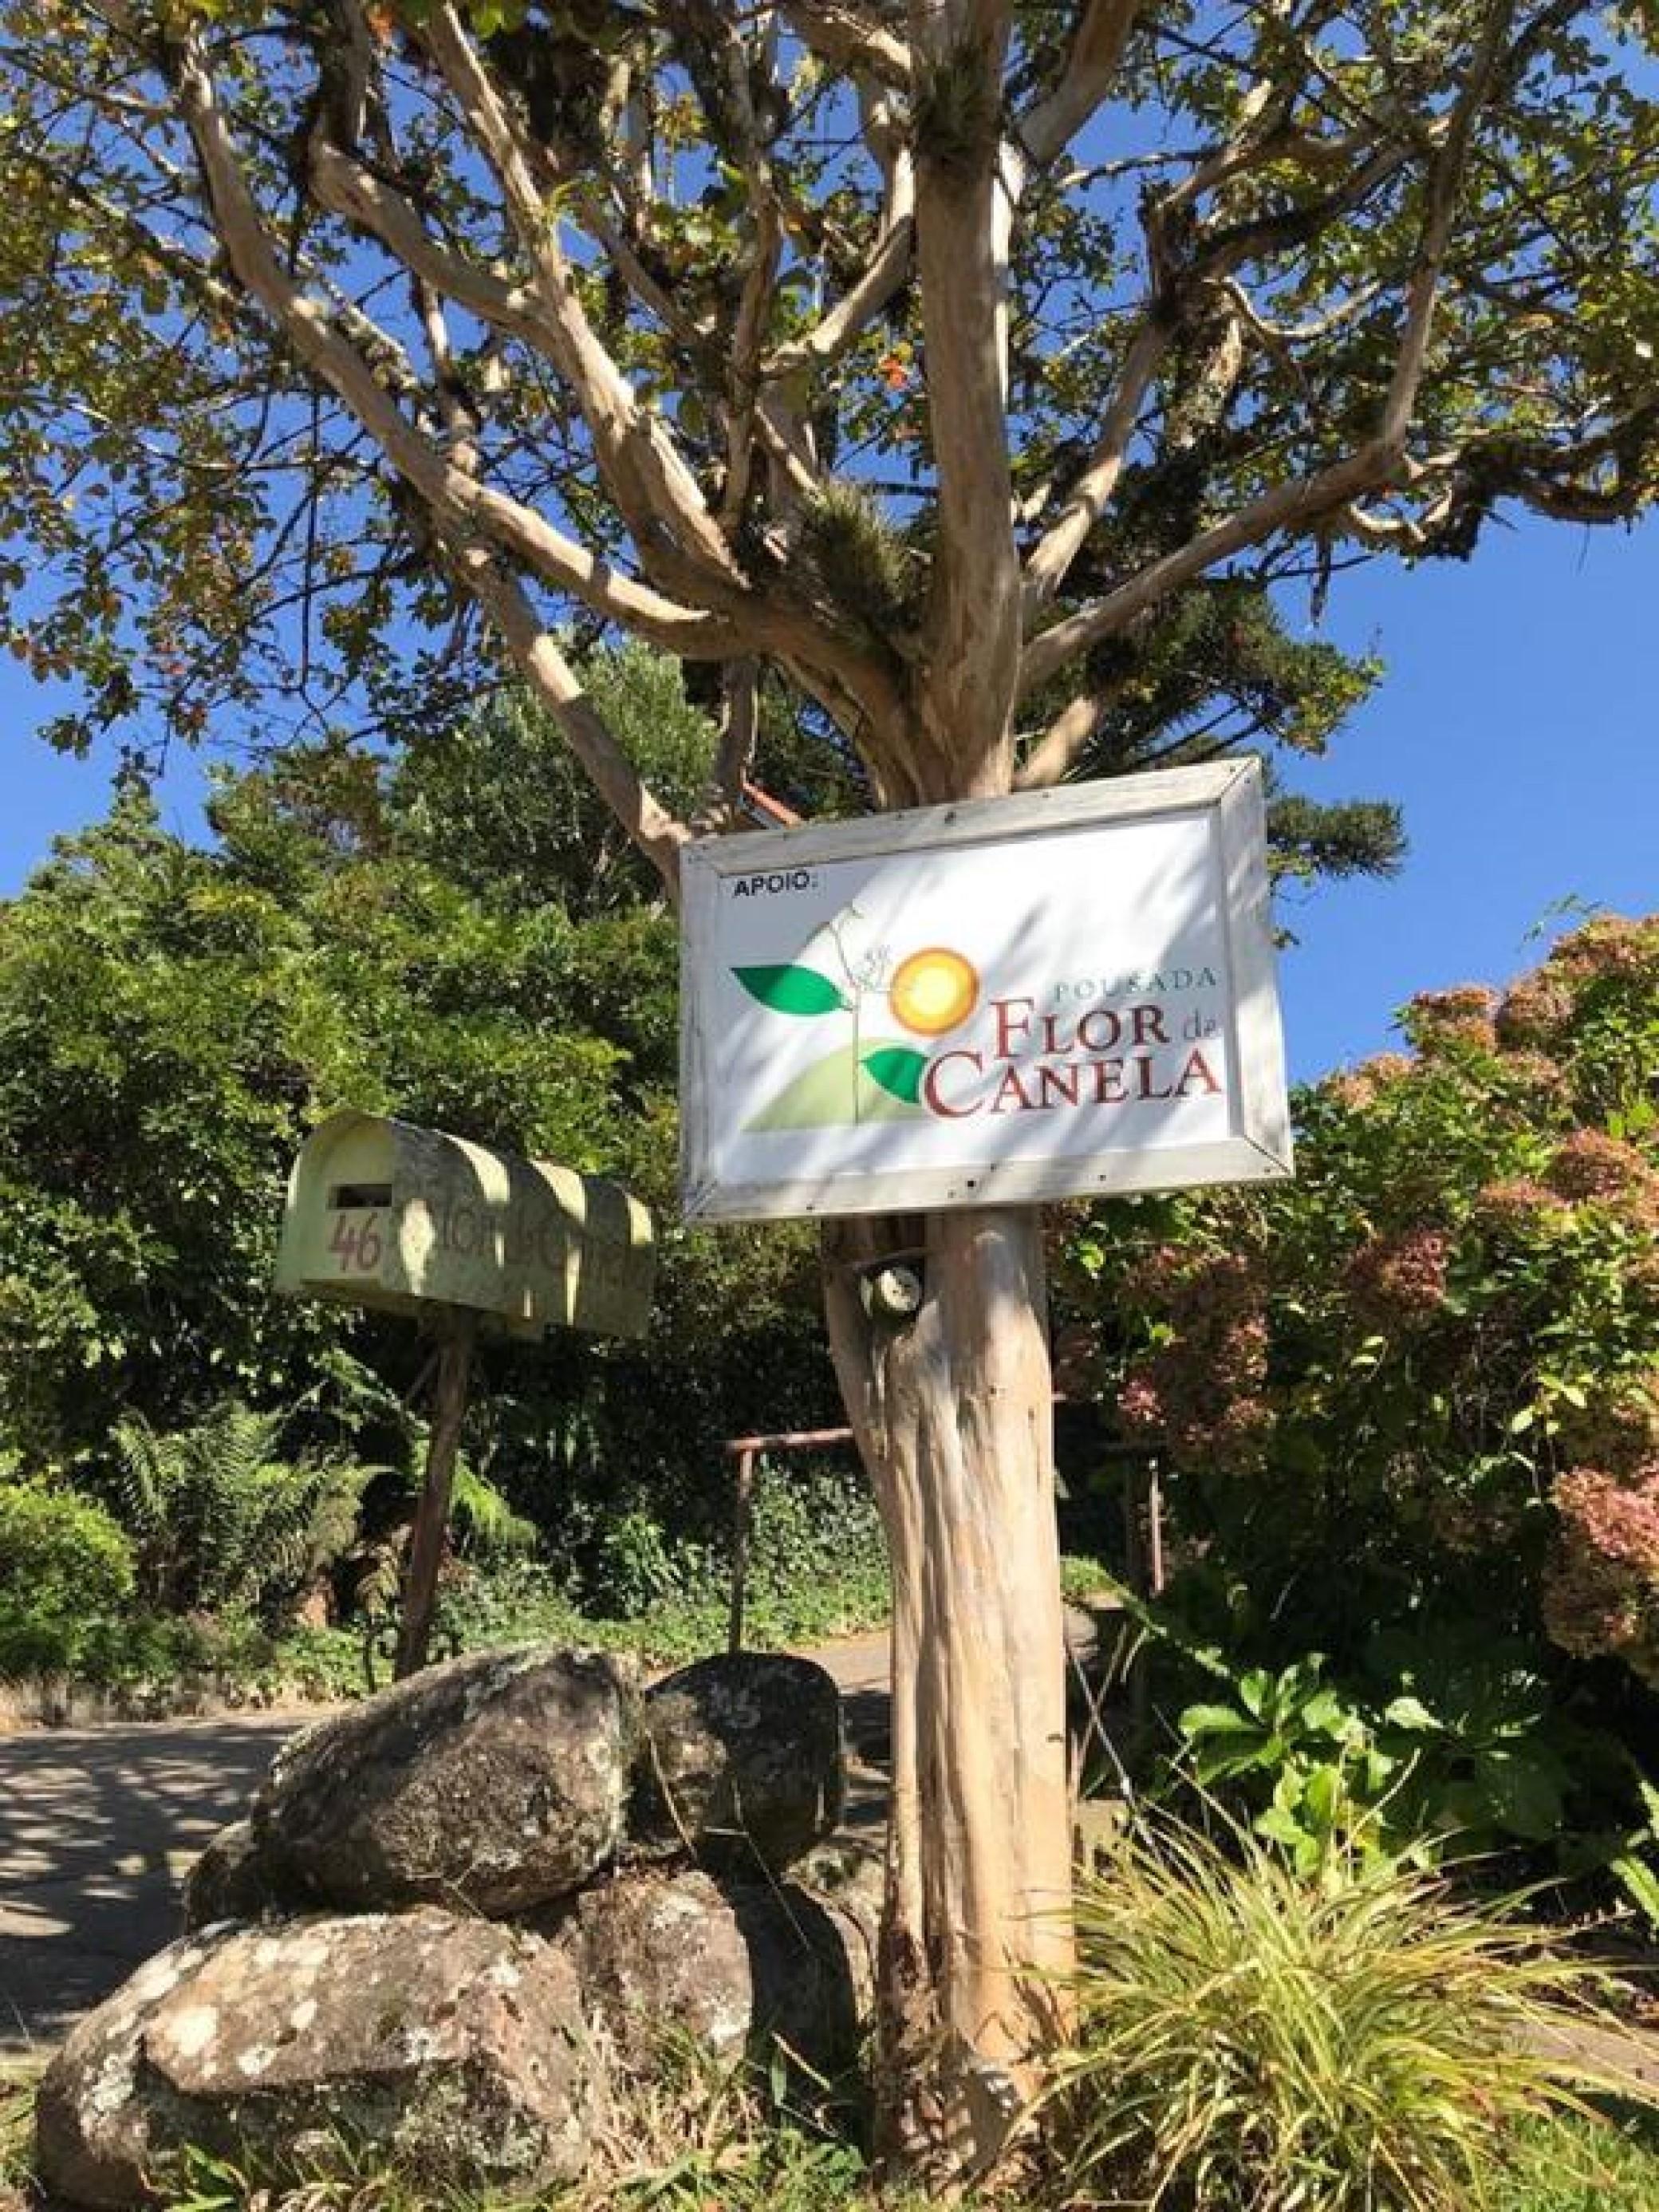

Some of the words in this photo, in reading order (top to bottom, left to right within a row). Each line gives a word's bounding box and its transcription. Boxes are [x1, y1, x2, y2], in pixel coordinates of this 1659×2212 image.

[734, 870, 818, 897] APOIO:
[990, 997, 1170, 1059] FLOR
[924, 1047, 1222, 1118] CANELA
[329, 1212, 382, 1272] 46
